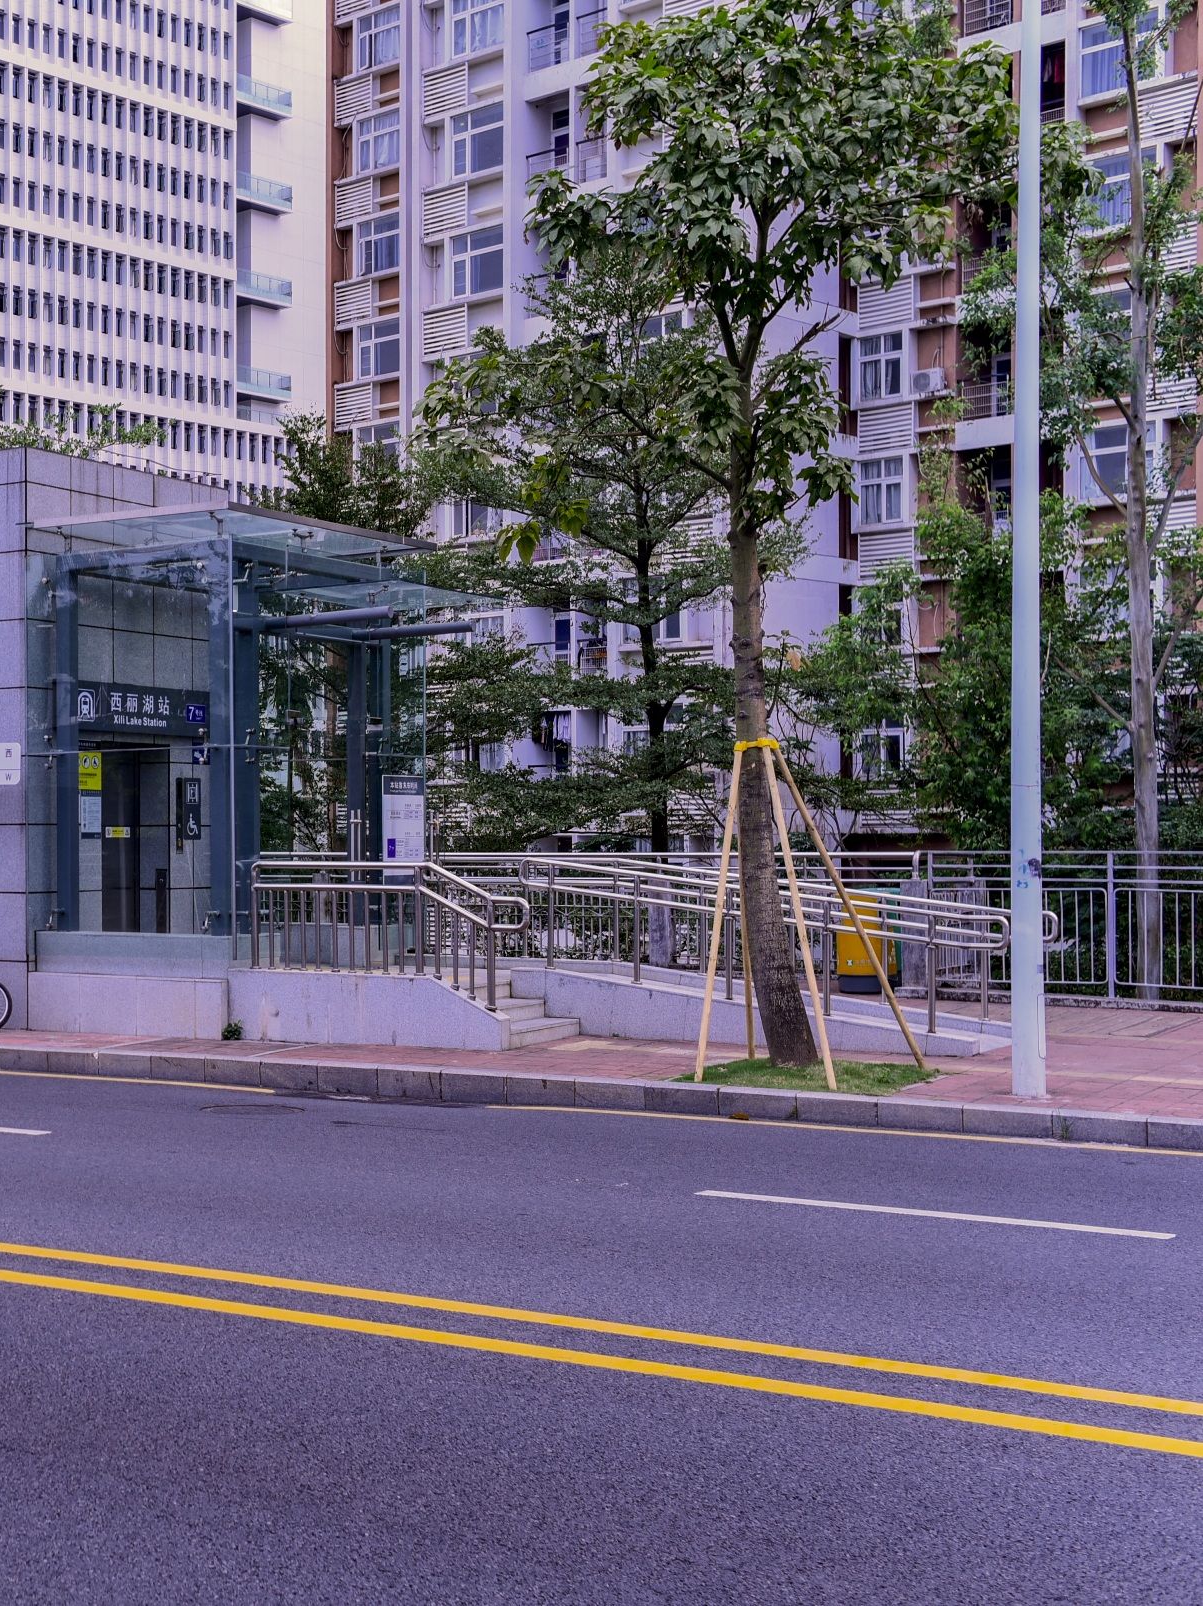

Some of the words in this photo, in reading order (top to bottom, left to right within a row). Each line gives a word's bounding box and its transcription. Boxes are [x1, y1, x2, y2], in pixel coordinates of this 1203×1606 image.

[110, 692, 170, 716] 西丽湖站
[113, 714, 126, 725] Xili
[126, 716, 142, 726] Lake
[143, 717, 167, 728] Station
[5, 748, 13, 758] 西
[5, 773, 12, 781] W
